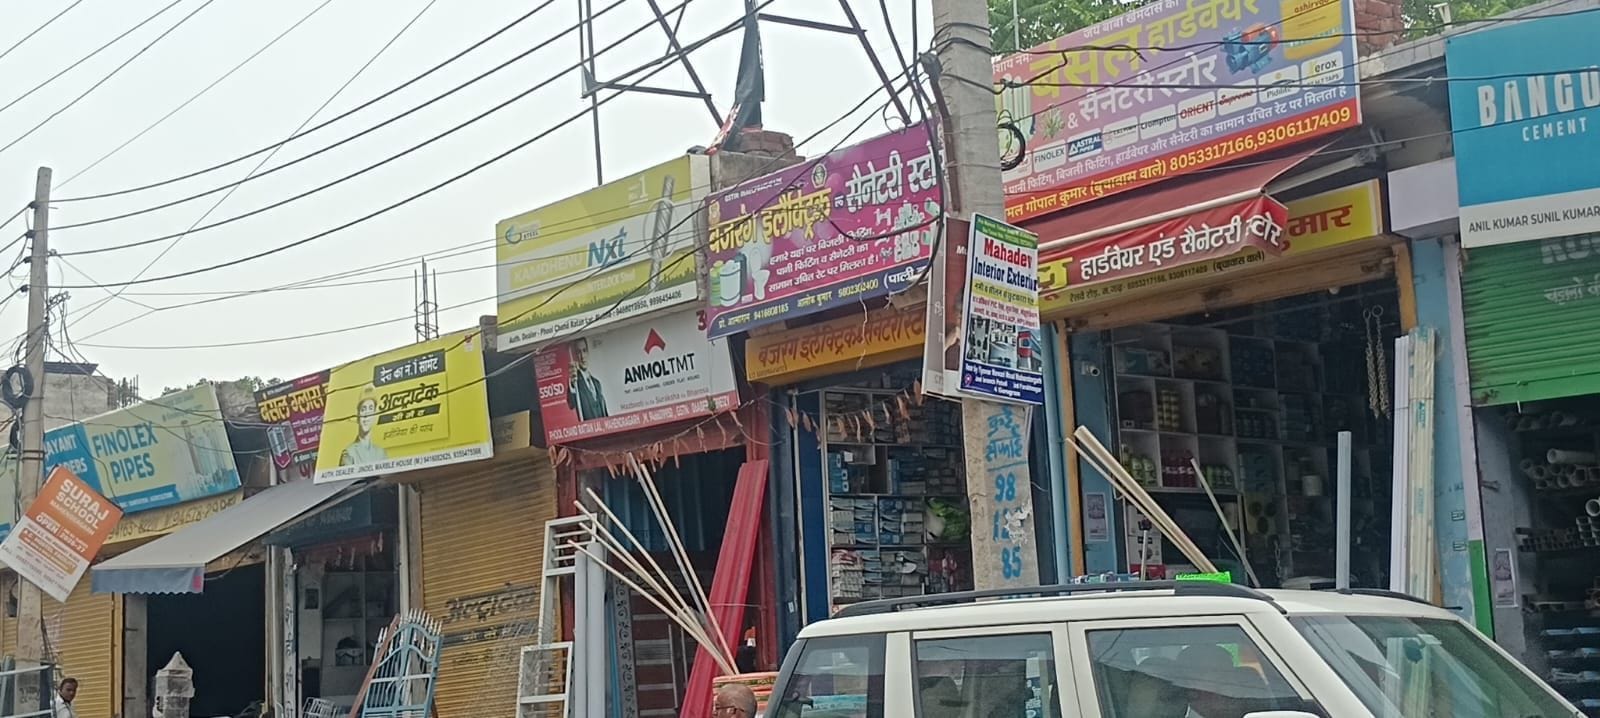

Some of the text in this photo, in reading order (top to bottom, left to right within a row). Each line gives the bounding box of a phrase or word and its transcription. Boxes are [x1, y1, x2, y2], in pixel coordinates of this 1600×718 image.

[1029, 25, 1143, 98] बंसल
[1066, 112, 1079, 129] &
[1156, 50, 1219, 100] स्टोर
[1180, 100, 1215, 120] ORIENT
[1076, 134, 1101, 149] ASTRAL
[1522, 117, 1587, 142] CEMENT
[1034, 148, 1065, 165] FINOLEX
[1026, 194, 1058, 212] गोपाल
[1059, 186, 1088, 207] कुमार
[1468, 204, 1600, 233] ANIL KUMAR SUNIL KUMAR
[587, 225, 628, 268] Nxt
[983, 237, 1033, 269] Mahadev
[1080, 244, 1145, 281] हार्डवेयर
[1149, 232, 1176, 267] एंड
[1180, 213, 1242, 256] सैनेटरी
[974, 256, 1006, 282] Interior
[91, 421, 159, 458] FINOLEX
[110, 452, 156, 485] PIPES
[395, 459, 413, 470] HOUSE
[60, 478, 111, 520] SURAJ
[994, 471, 1017, 502] 98
[35, 514, 60, 535] OPEN
[55, 490, 99, 530] SCHOOL
[1001, 546, 1023, 580] 85
